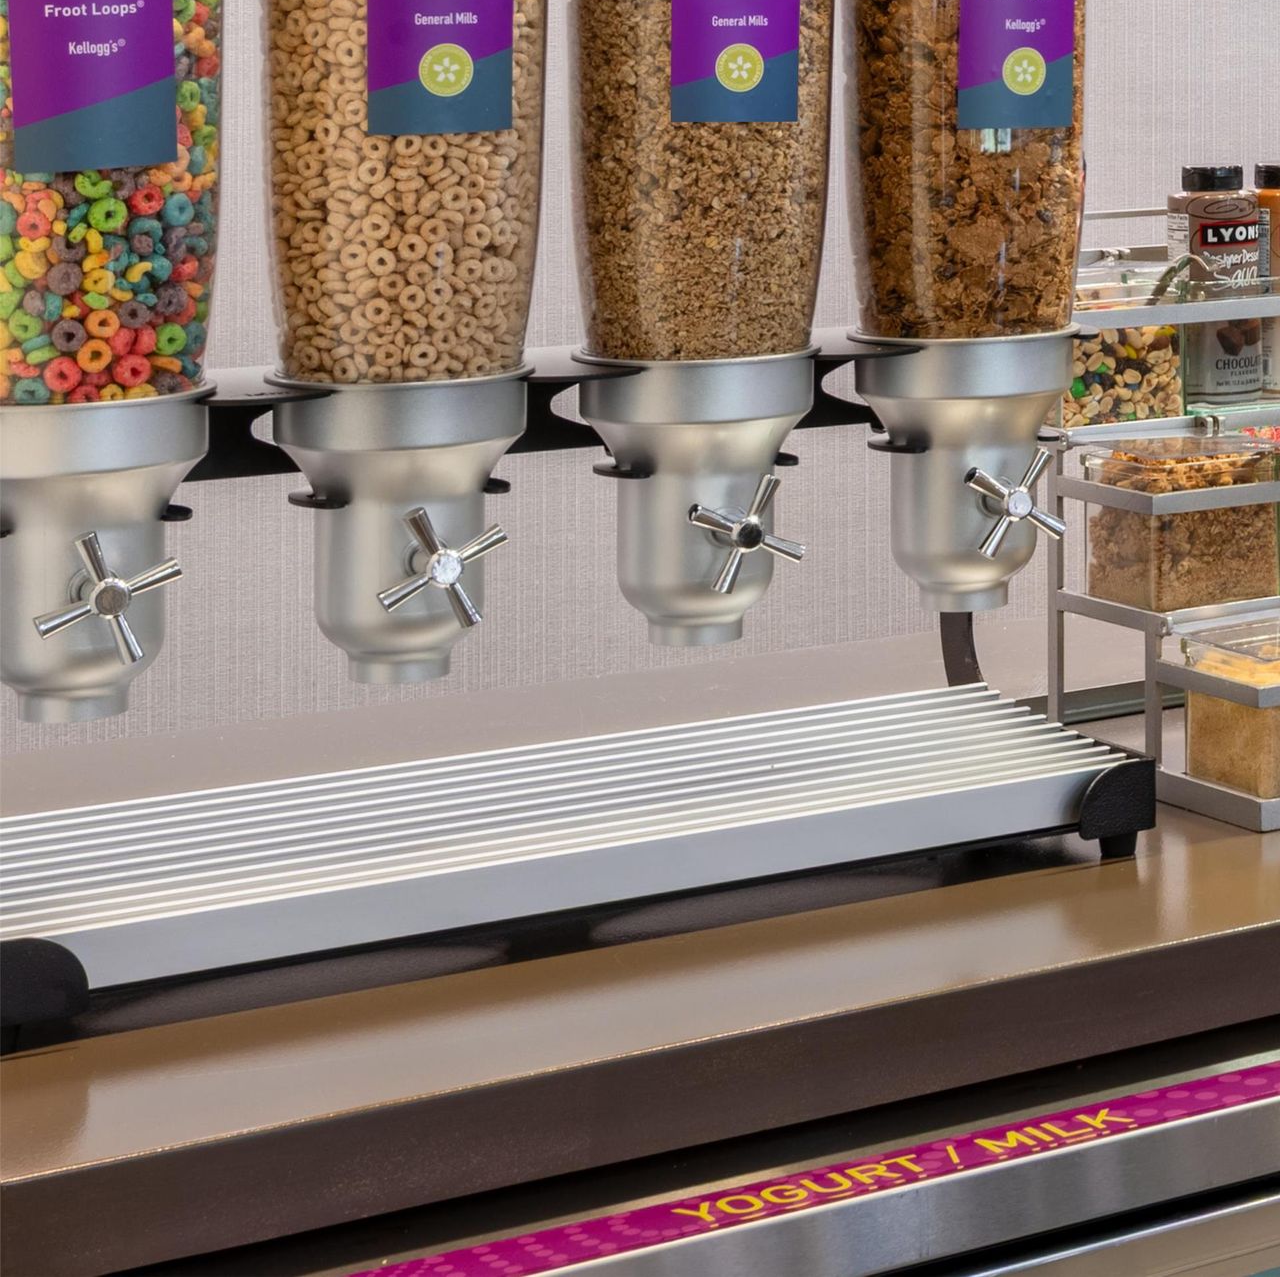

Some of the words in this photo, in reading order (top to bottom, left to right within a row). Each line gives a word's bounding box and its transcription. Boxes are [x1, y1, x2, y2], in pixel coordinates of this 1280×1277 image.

[44, 4, 87, 17] Froot
[414, 12, 454, 26] General
[455, 12, 478, 25] Mills
[712, 15, 747, 27] General
[748, 15, 769, 27] Mills
[671, 1153, 928, 1222] YOGURT
[946, 1144, 963, 1165] /
[975, 1108, 1135, 1154] MILK
